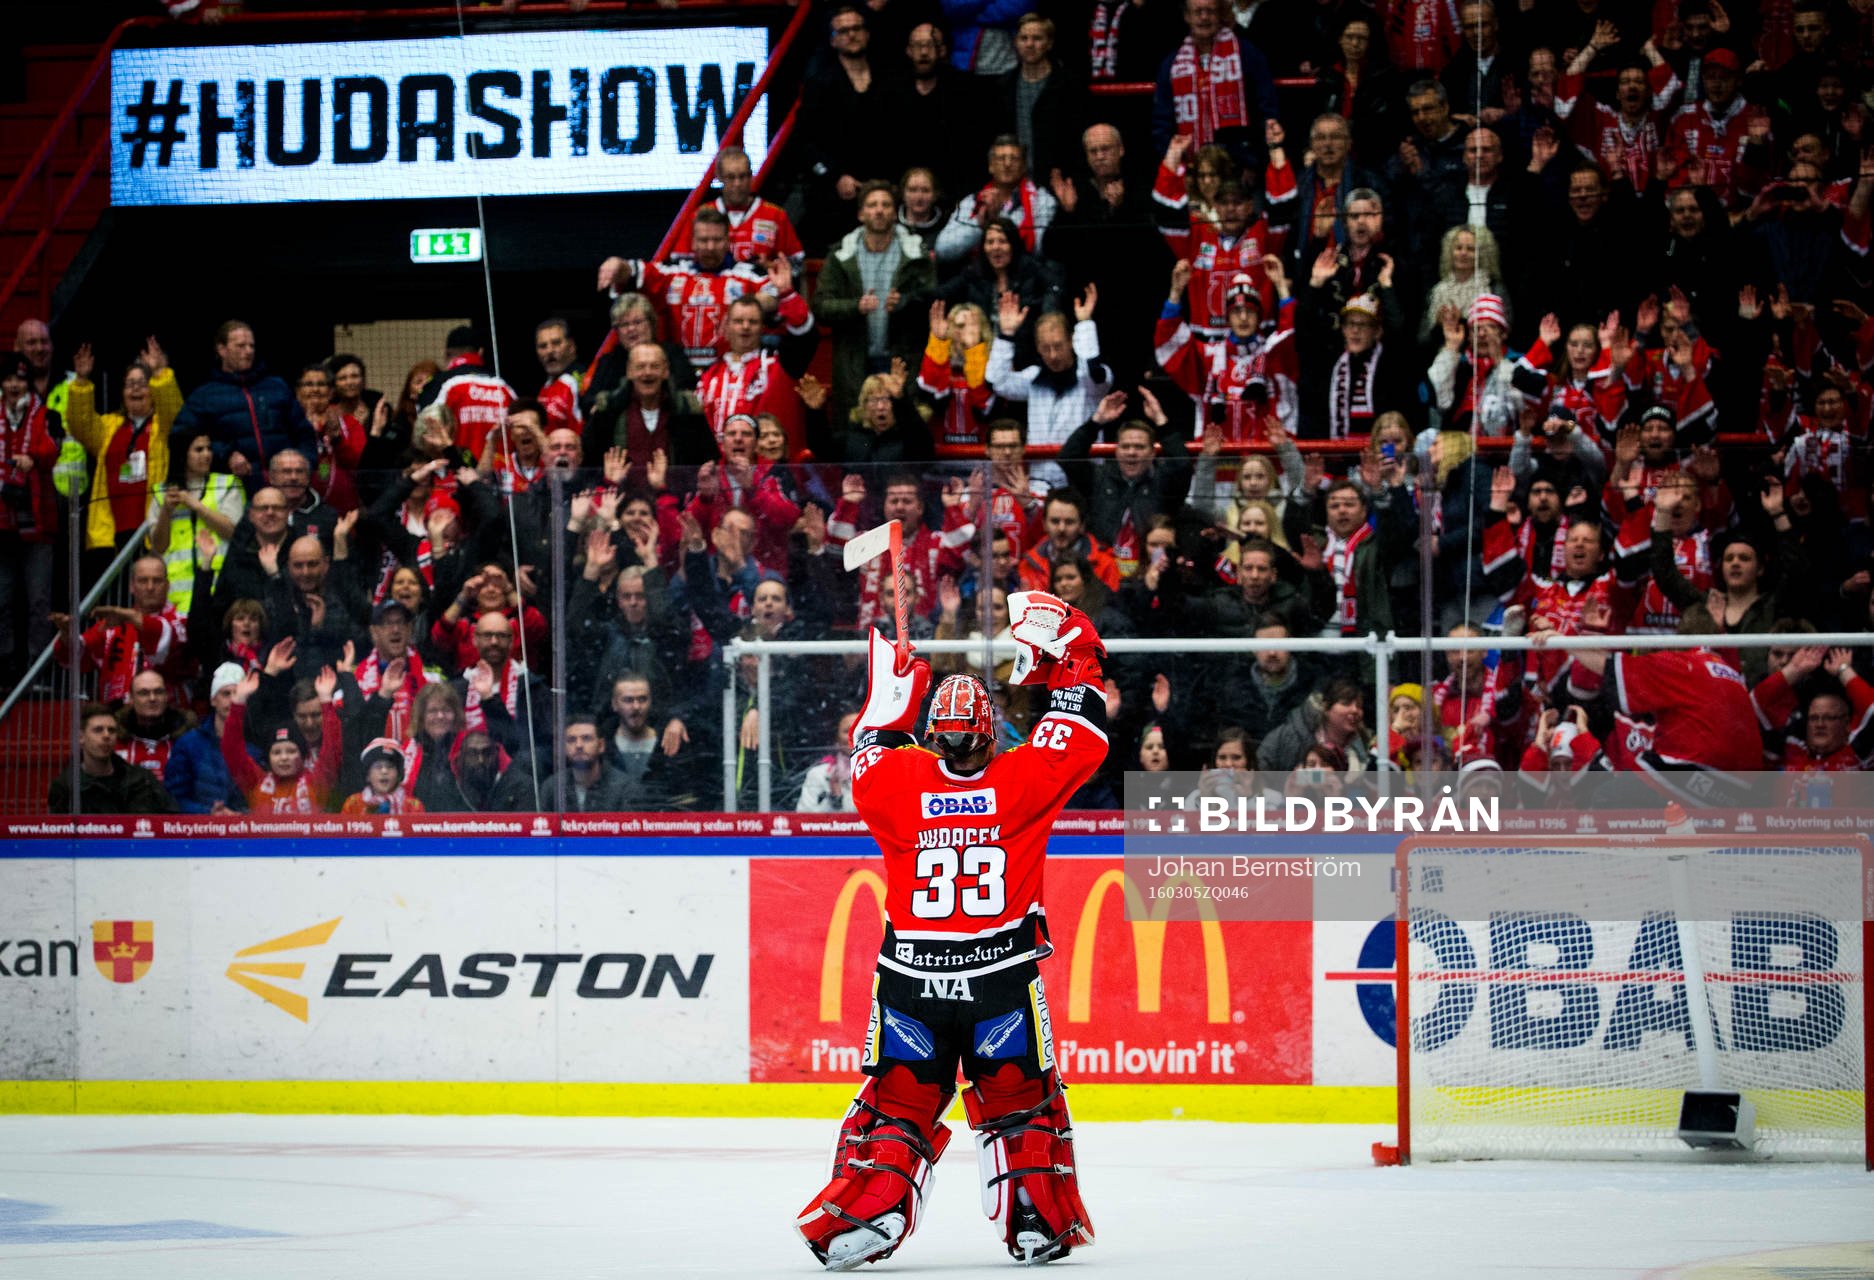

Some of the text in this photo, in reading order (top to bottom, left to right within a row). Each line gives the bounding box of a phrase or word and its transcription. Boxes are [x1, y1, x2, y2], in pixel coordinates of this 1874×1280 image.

[121, 61, 756, 169] #HUDASHOW
[1032, 721, 1073, 750] 33
[928, 794, 988, 816] ÖBAB
[163, 820, 373, 835] Rekrytering och bemanning sedan 1996
[411, 821, 522, 833] www.kornboden.se
[622, 820, 640, 832] och
[642, 819, 701, 834] bemanning
[703, 819, 734, 831] sedan
[737, 819, 763, 831] 1996
[1539, 818, 1567, 829] 1996
[1766, 816, 1832, 831] Rekrytering
[912, 845, 1007, 919] 33
[323, 952, 714, 999] EASTON
[920, 977, 974, 1002] NA
